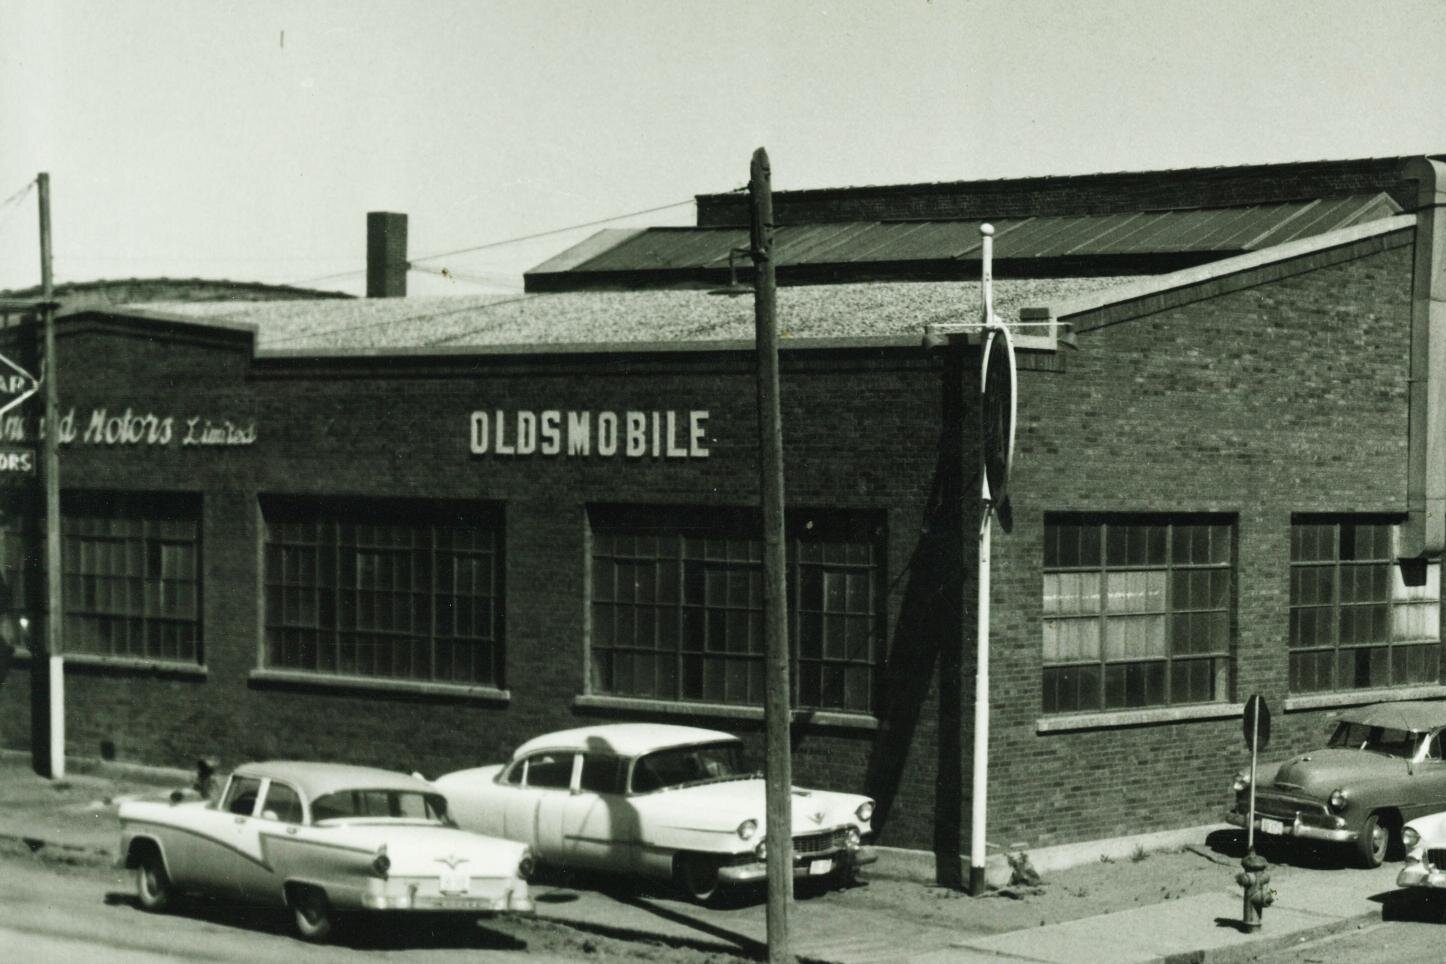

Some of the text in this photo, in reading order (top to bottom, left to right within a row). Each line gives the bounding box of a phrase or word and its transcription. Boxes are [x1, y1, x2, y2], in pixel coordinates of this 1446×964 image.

[84, 407, 174, 445] Motors
[182, 416, 257, 445] Limited
[470, 410, 710, 457] OLDSMOBILE
